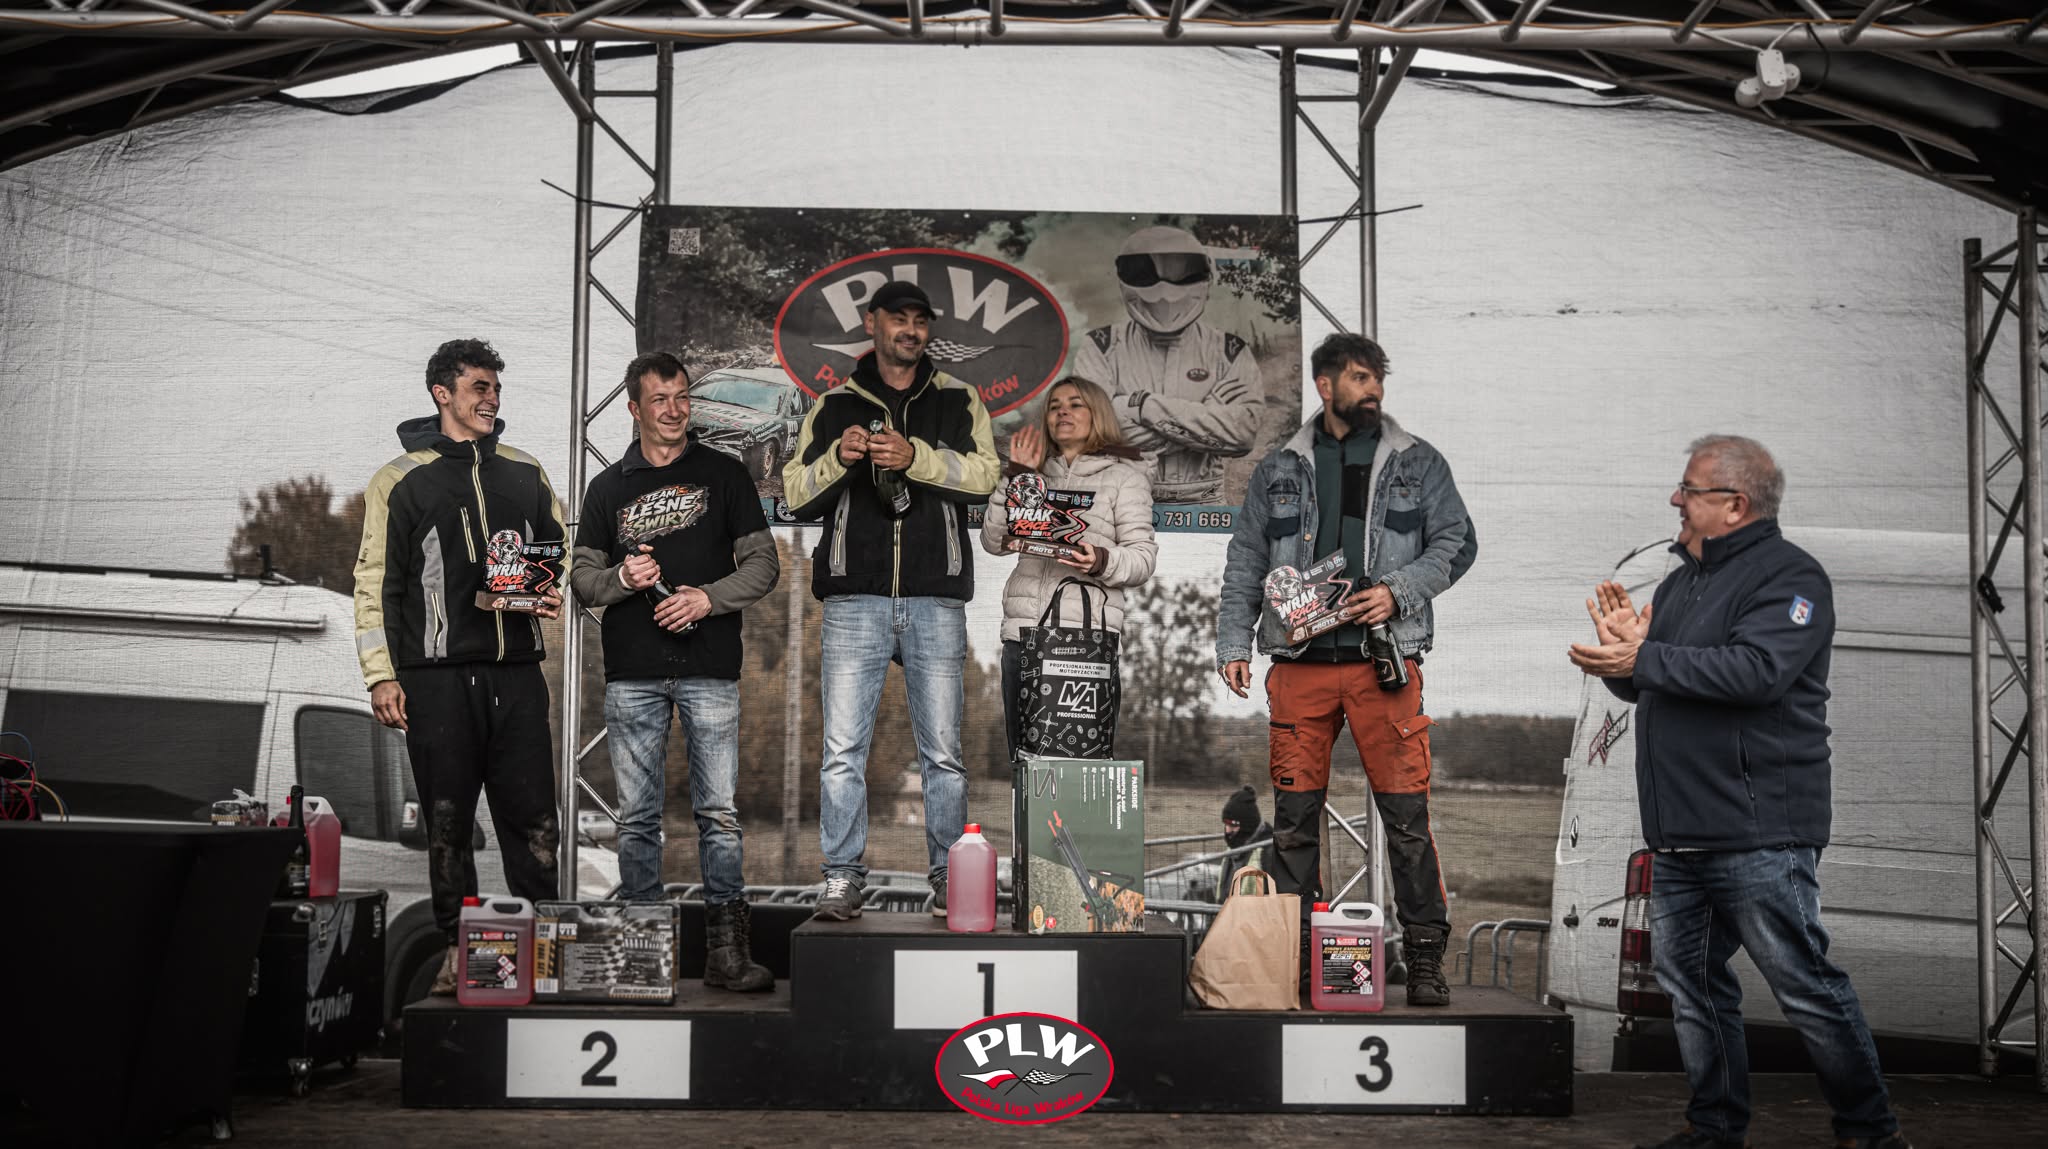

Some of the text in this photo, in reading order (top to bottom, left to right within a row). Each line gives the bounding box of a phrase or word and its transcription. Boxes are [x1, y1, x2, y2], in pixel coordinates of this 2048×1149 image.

[977, 374, 1019, 403] ków
[644, 488, 677, 502] TEAM
[1008, 507, 1054, 522] WRAK
[1163, 511, 1232, 528] 731 669
[1014, 520, 1050, 530] RACE
[1028, 545, 1054, 554] PROTO
[486, 563, 528, 579] WRAK
[491, 575, 524, 588] RACE
[1275, 586, 1318, 619] WRAK
[1288, 598, 1320, 626] RACE
[1312, 617, 1336, 632] PROTO
[1057, 680, 1097, 712] MA
[1056, 711, 1097, 719] PROFESSIONAL
[977, 962, 995, 1018] 1
[581, 1030, 617, 1087] 2
[1355, 1035, 1393, 1092] 3
